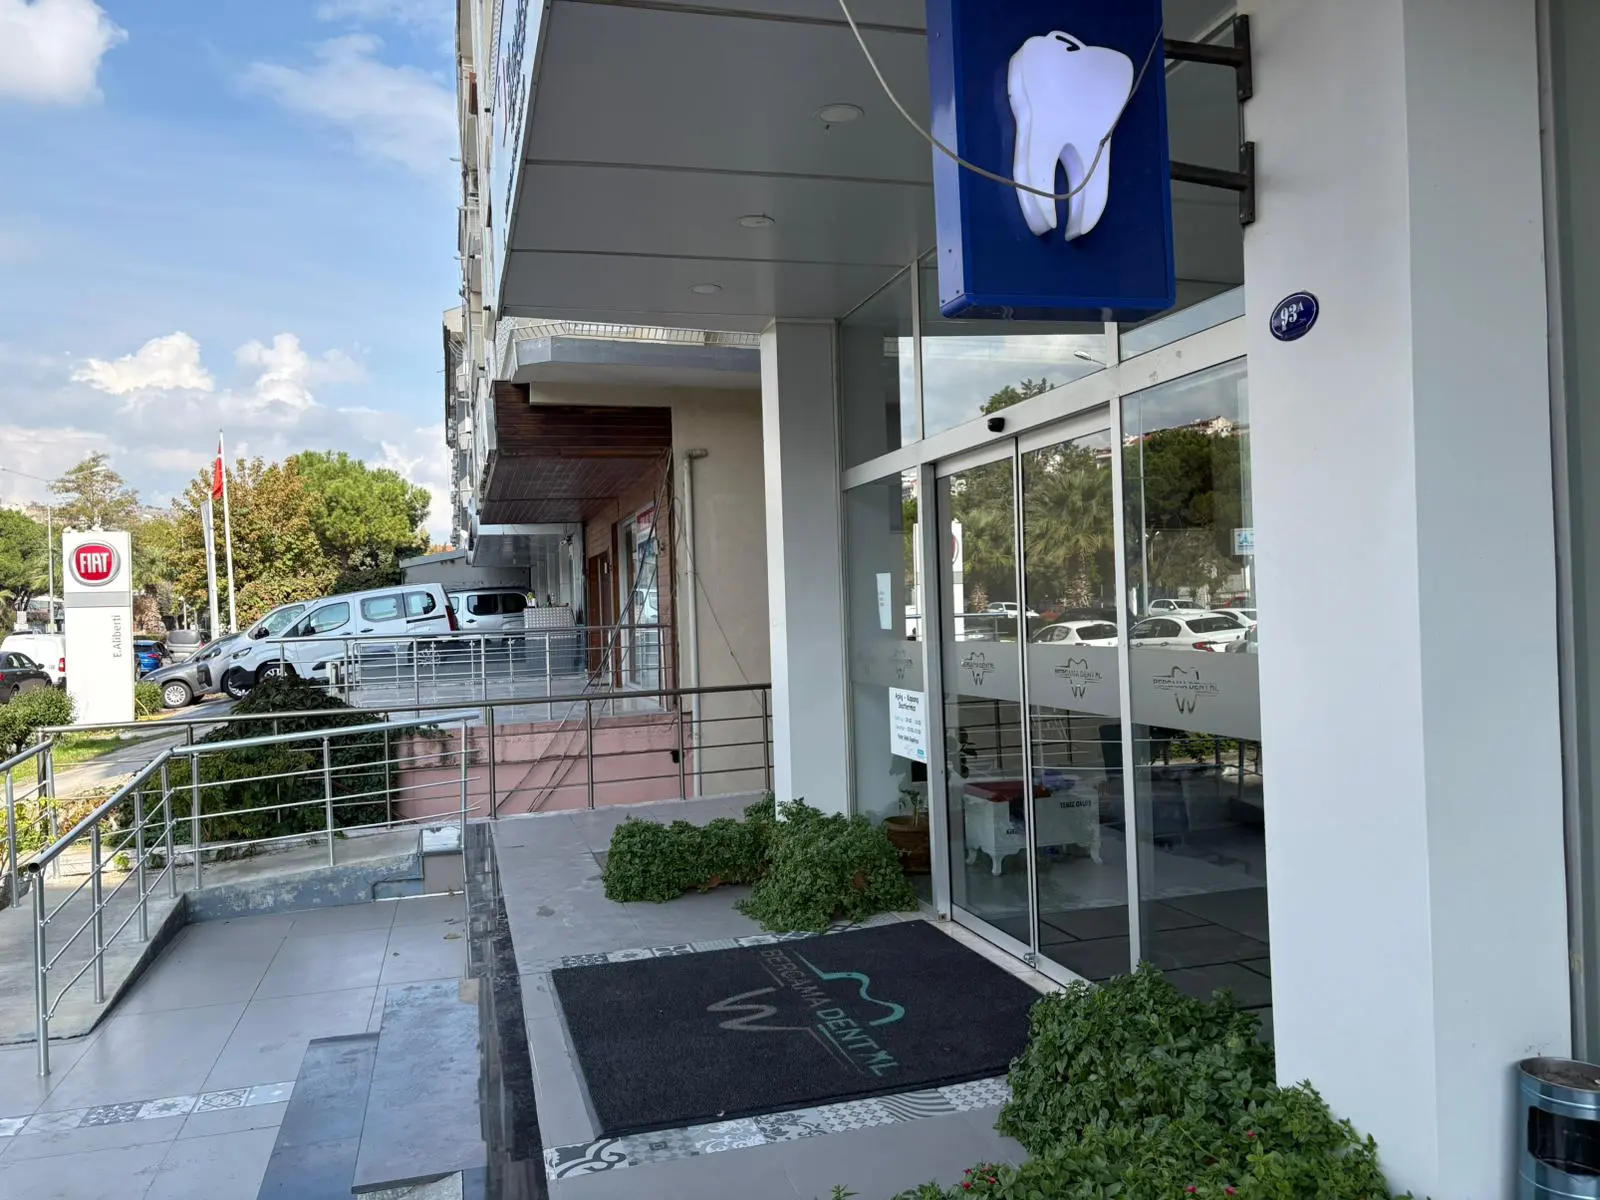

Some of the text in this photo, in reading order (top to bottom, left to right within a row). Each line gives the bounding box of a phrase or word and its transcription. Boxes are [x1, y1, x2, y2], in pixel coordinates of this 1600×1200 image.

[80, 553, 109, 573] FIAT
[112, 615, 122, 658] E.Aliberti
[759, 949, 832, 1009] BERGAMA
